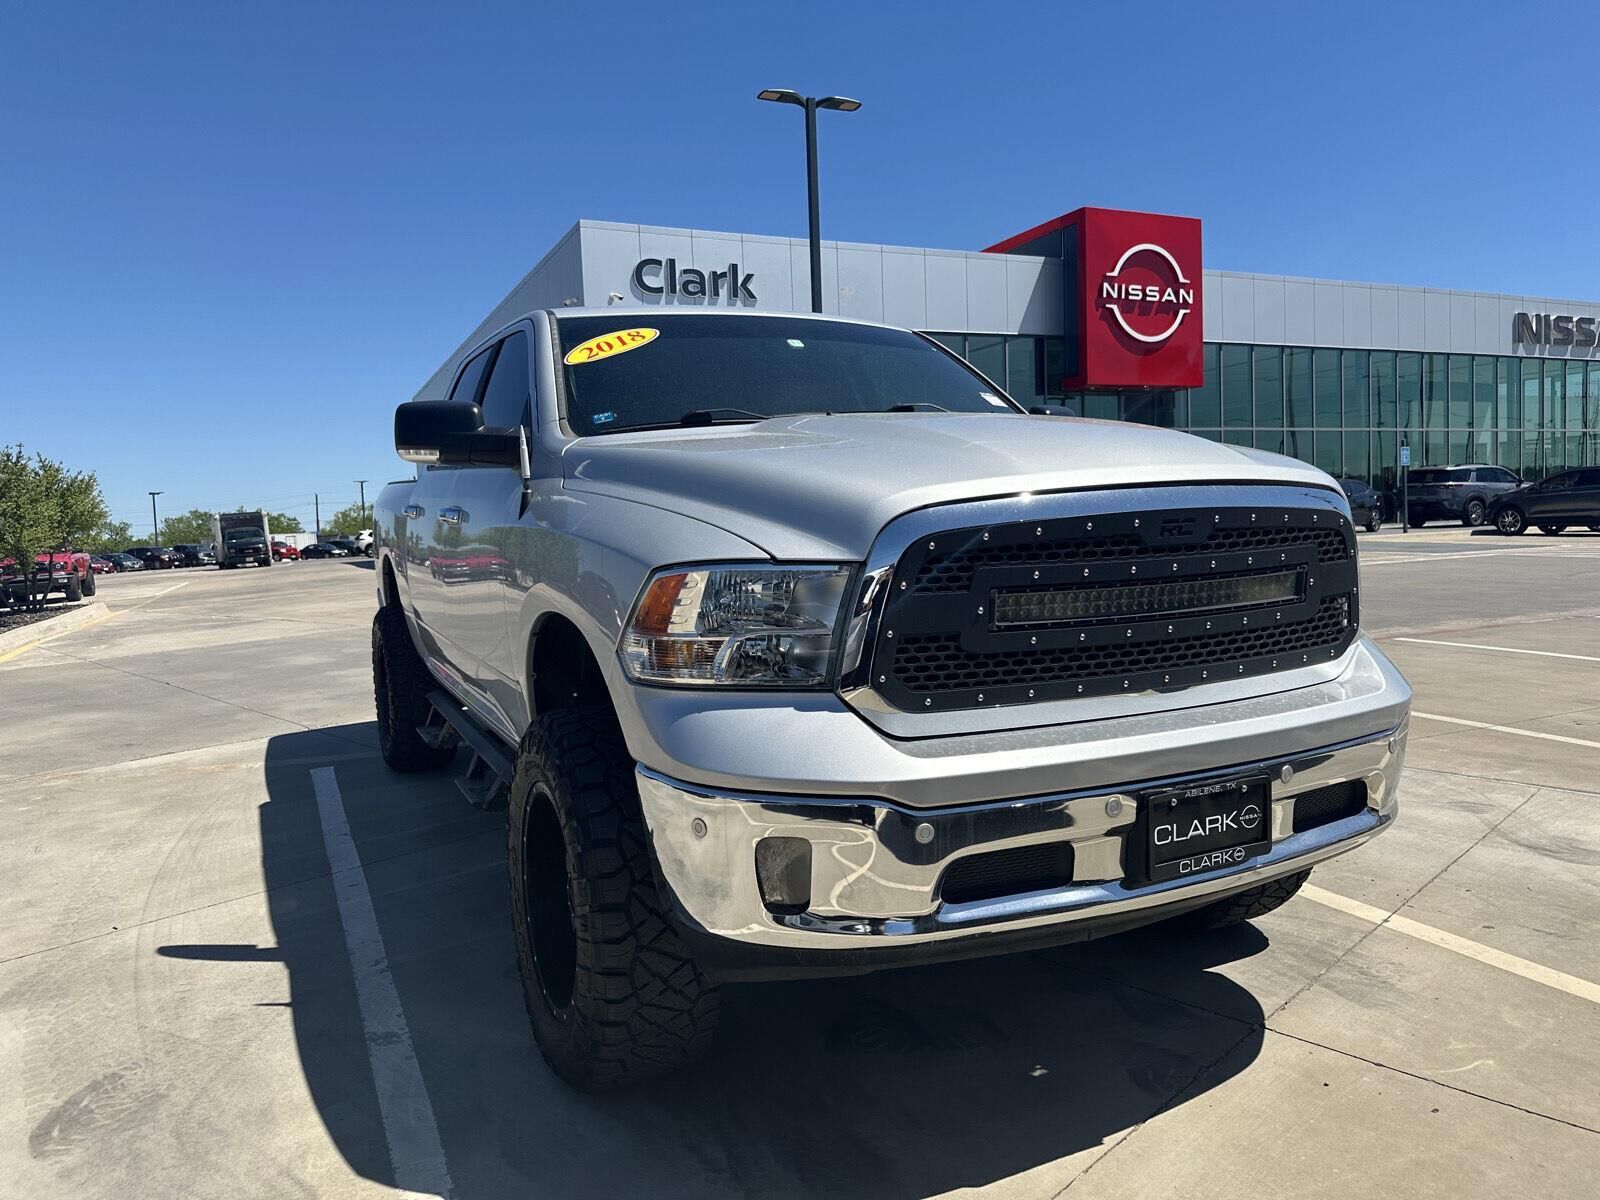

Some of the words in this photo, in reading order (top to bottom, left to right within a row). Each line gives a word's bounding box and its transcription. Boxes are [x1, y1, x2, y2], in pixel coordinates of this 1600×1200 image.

[633, 258, 758, 300] Clark
[1102, 282, 1194, 304] NISSAN
[1514, 312, 1600, 347] NISS
[579, 330, 647, 360] 2018
[1226, 782, 1237, 790] TX
[1154, 810, 1238, 845] CLARK
[1179, 850, 1233, 873] CLARK
